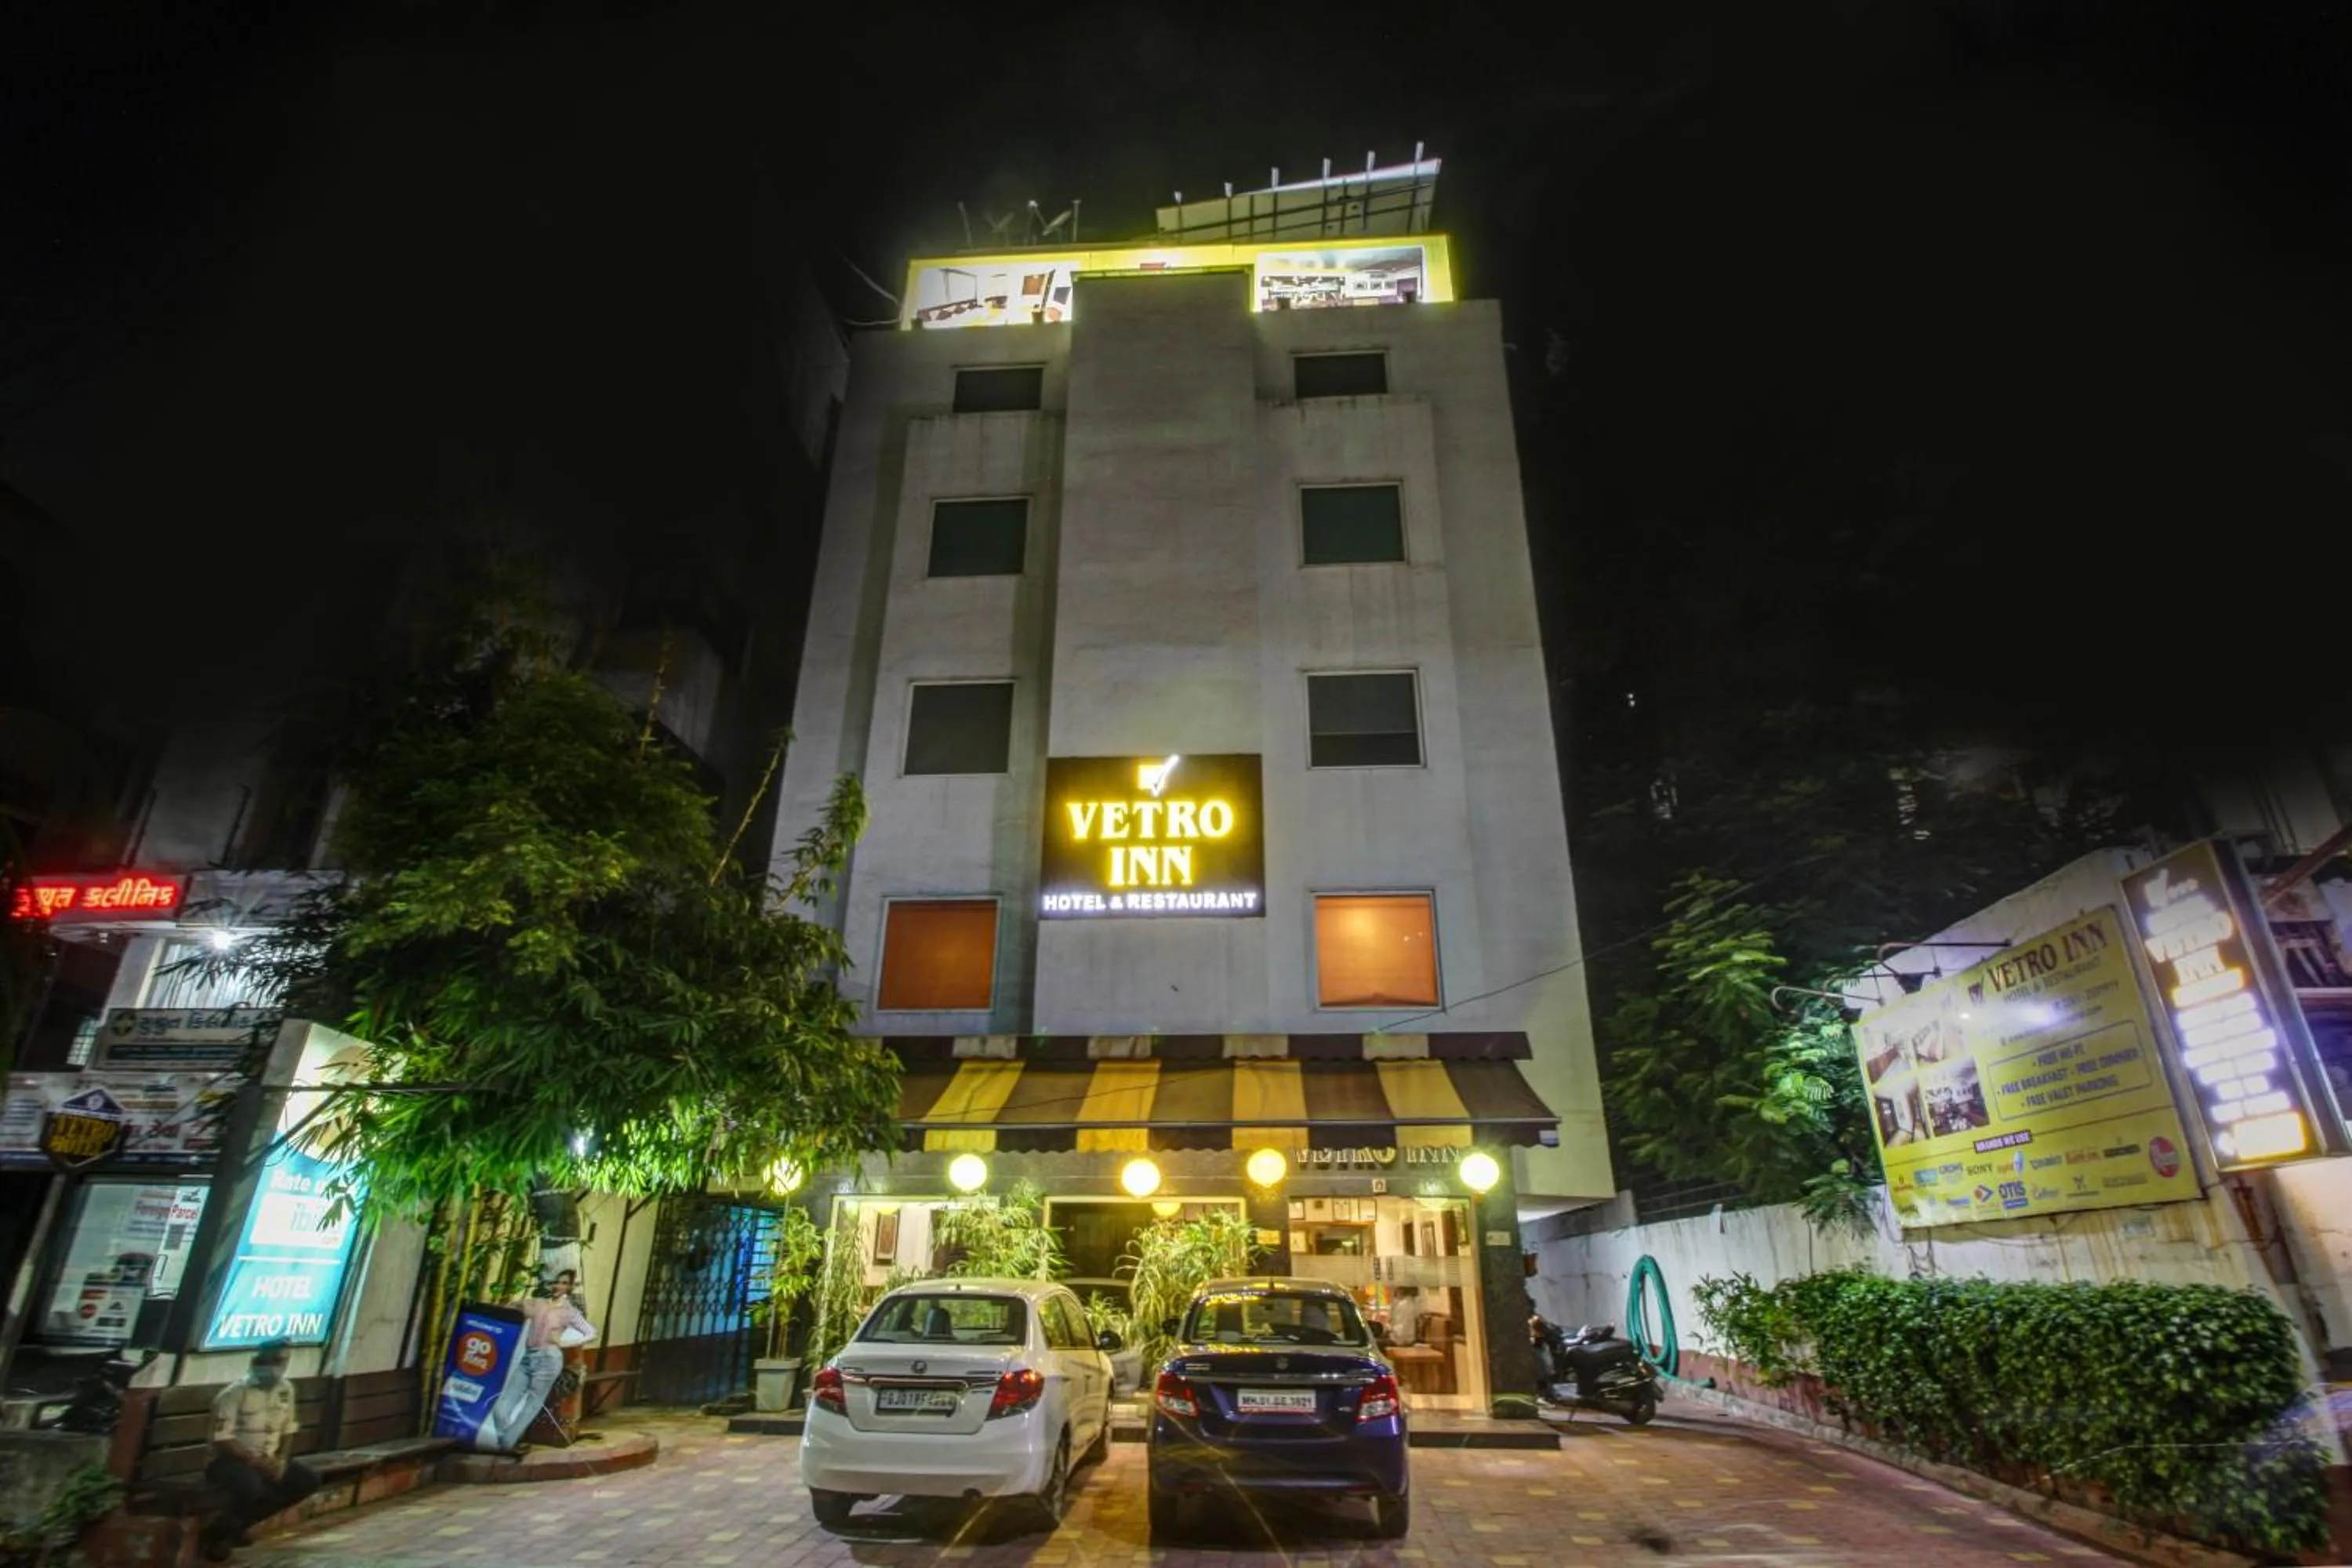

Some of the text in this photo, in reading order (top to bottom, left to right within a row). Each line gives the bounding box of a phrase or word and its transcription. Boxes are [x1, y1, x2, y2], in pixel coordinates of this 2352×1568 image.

[1065, 799, 1233, 839] VETRO
[1108, 847, 1192, 886] INN
[1044, 892, 1257, 910] HOTEL & RESTAURANT
[1987, 920, 2108, 992] VETRO INN
[251, 1274, 313, 1300] HOTEL
[218, 1312, 323, 1338] VETRO INN
